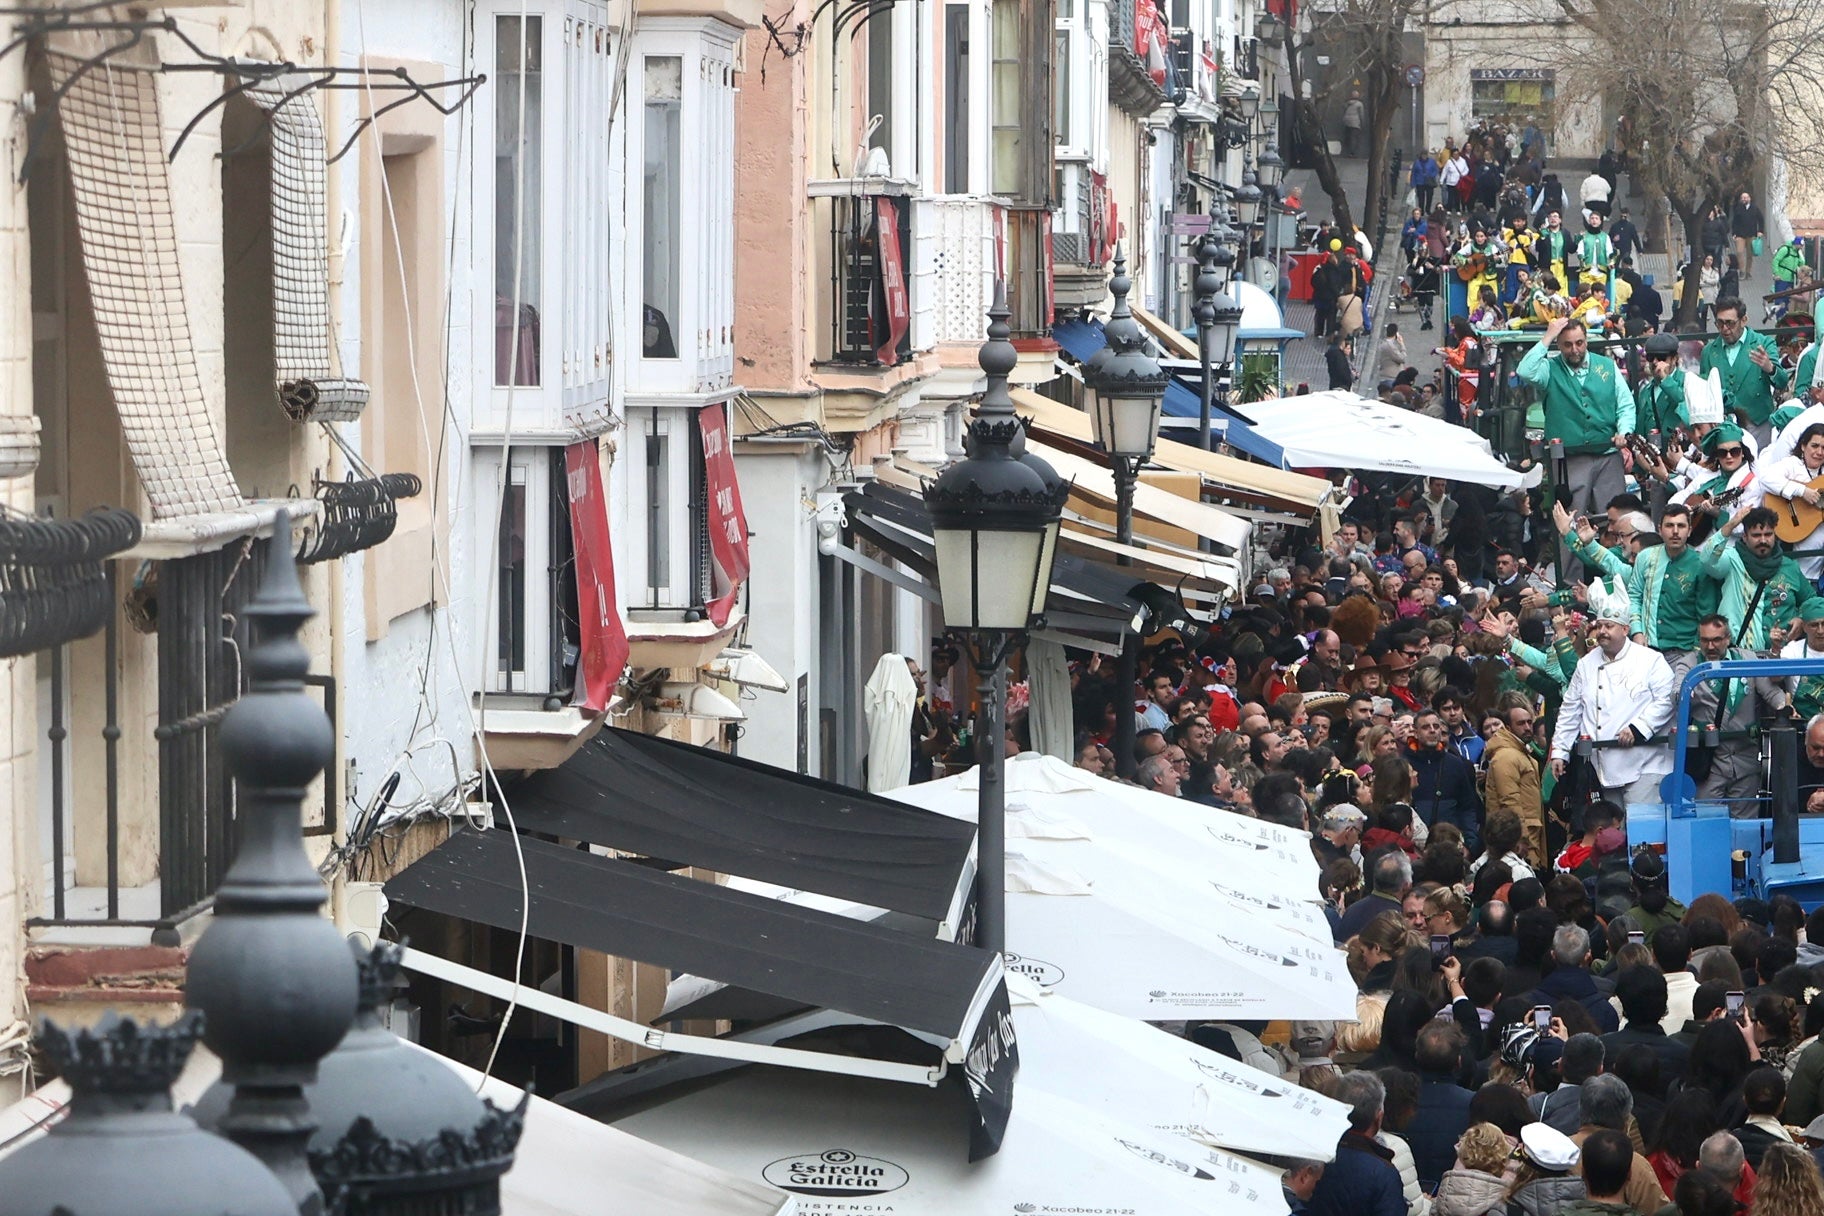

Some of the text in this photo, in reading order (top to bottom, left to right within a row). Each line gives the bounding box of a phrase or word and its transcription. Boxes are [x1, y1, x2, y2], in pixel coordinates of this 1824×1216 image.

[1481, 70, 1544, 78] BAZAR
[787, 1163, 884, 1177] Estrella
[790, 1173, 878, 1187] Galicia
[1042, 1205, 1103, 1214] Xacobeo
